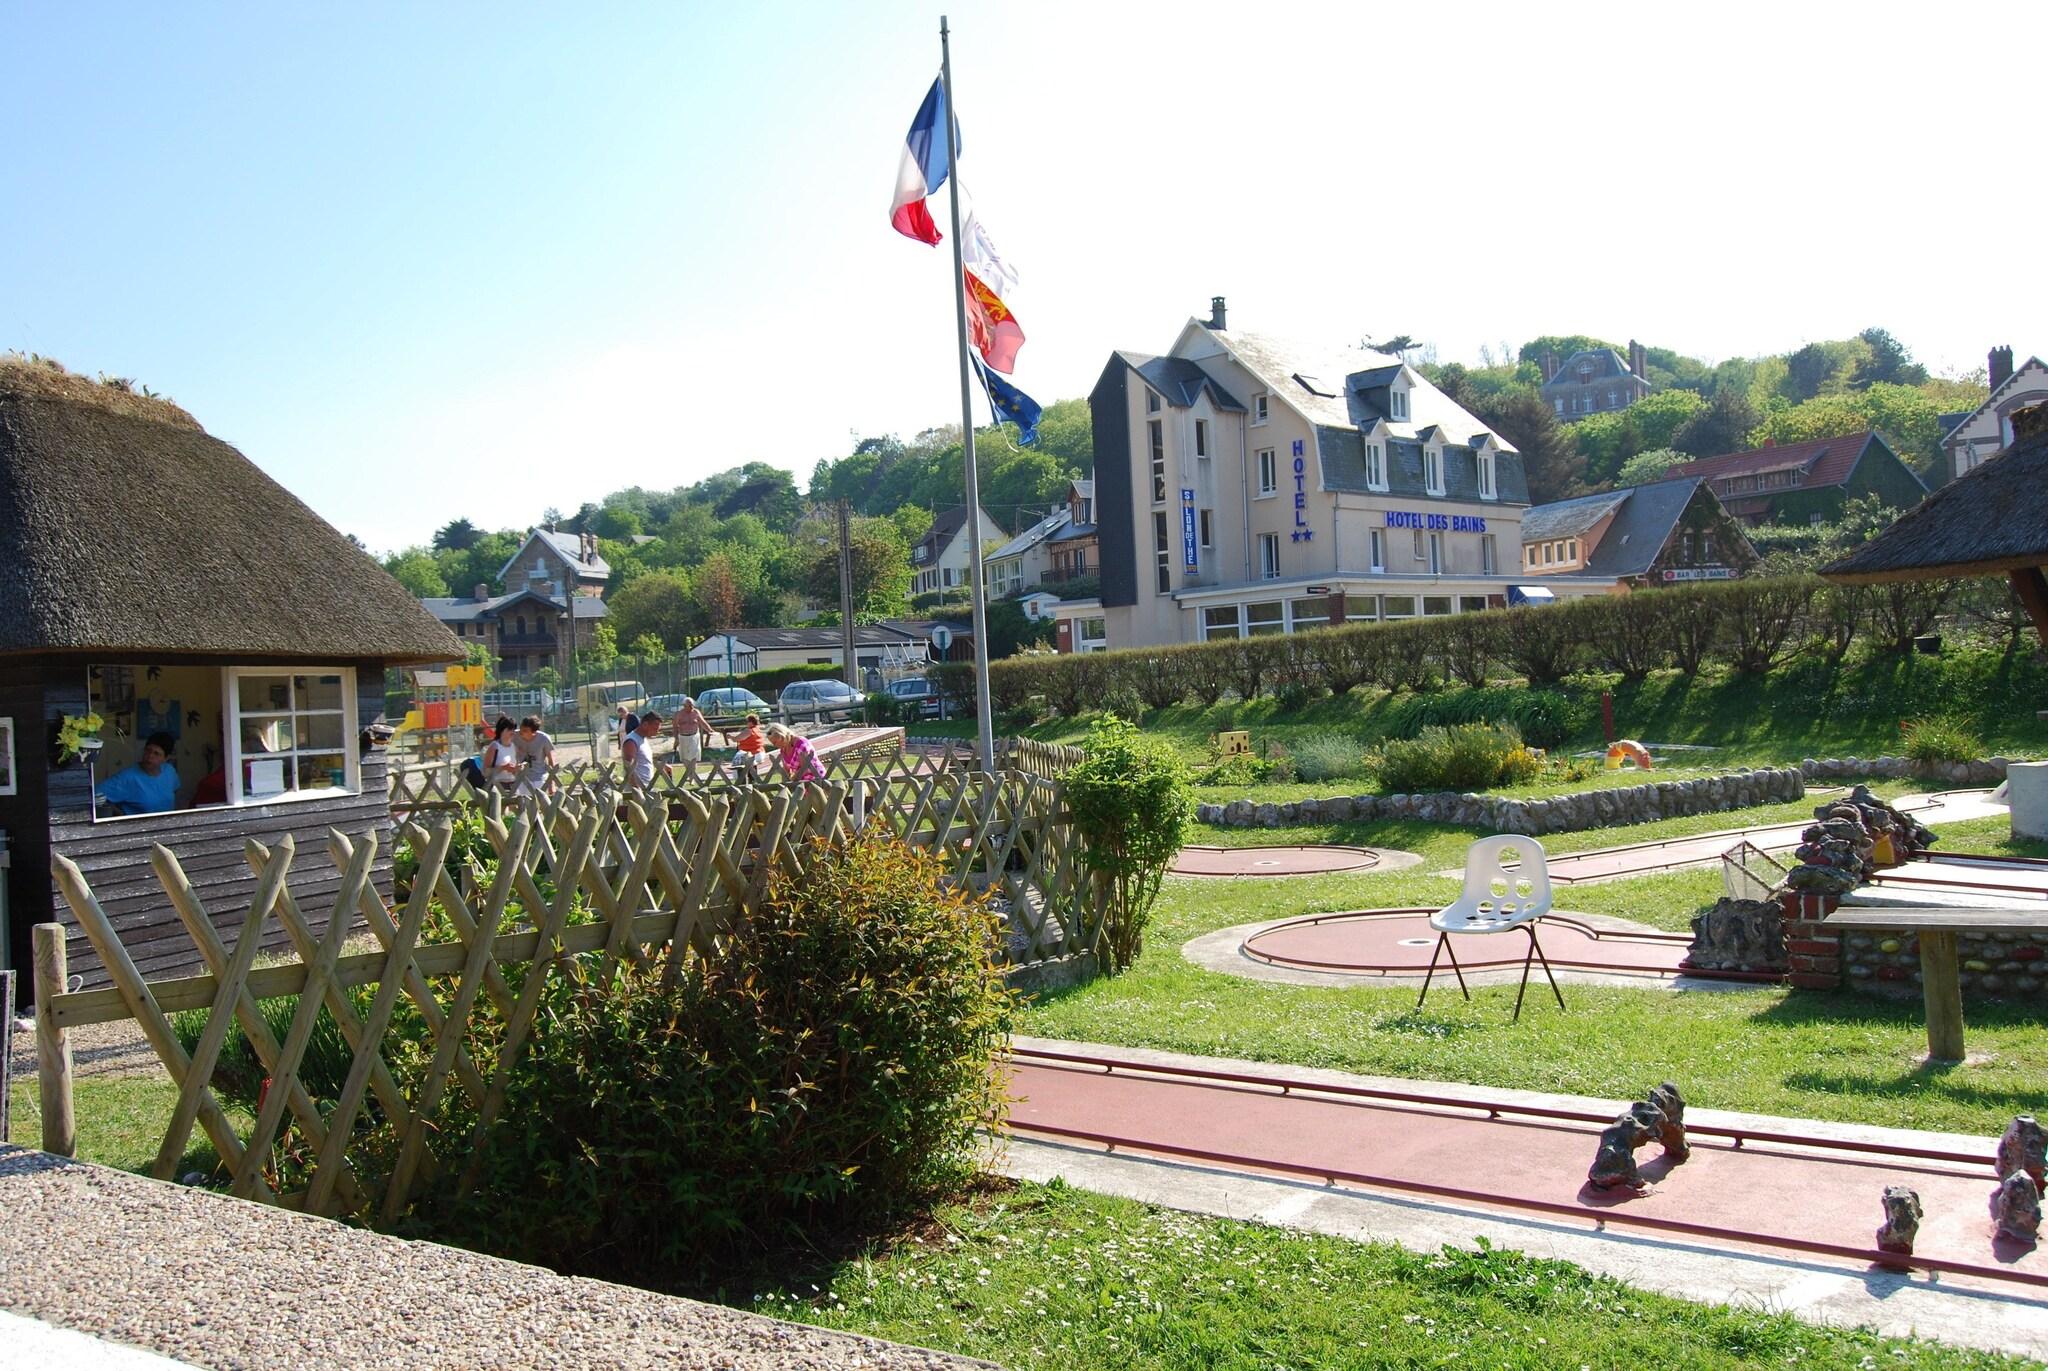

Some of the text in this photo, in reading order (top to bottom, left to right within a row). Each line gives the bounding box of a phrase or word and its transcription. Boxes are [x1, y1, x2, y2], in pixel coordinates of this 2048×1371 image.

[1292, 440, 1306, 527] HOTEL
[1386, 511, 1486, 533] HOTEL DES BAINS
